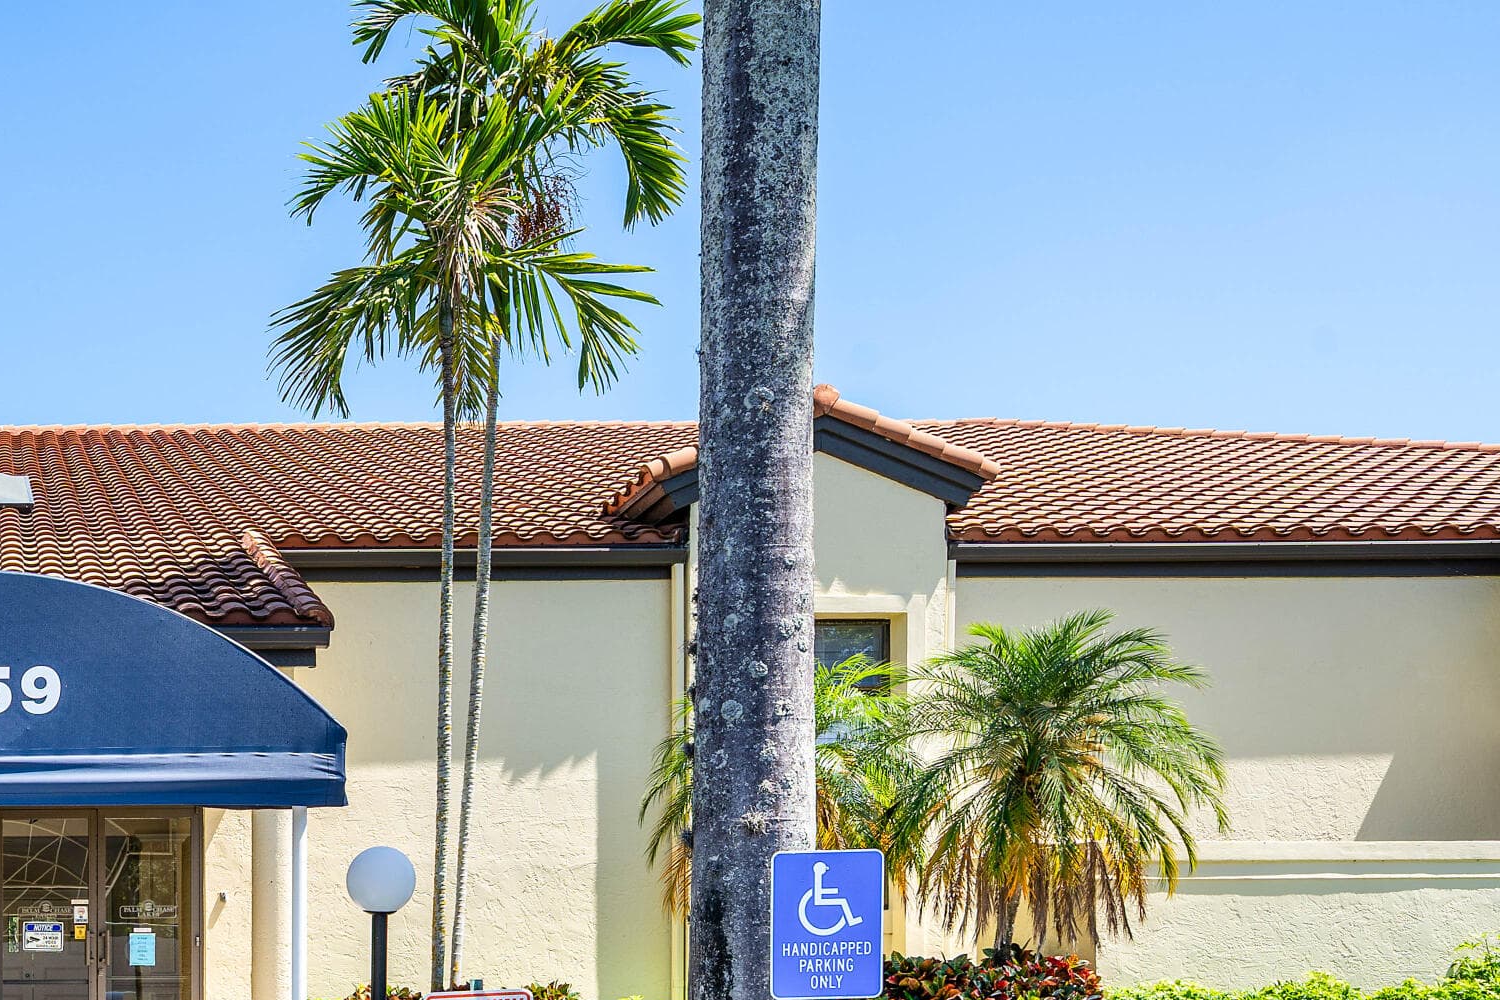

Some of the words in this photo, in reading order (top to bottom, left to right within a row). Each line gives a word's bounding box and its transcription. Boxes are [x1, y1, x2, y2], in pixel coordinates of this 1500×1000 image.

[782, 941, 872, 957] HANDICAPPED
[799, 957, 854, 973] PARKING
[810, 974, 844, 990] ONLY
